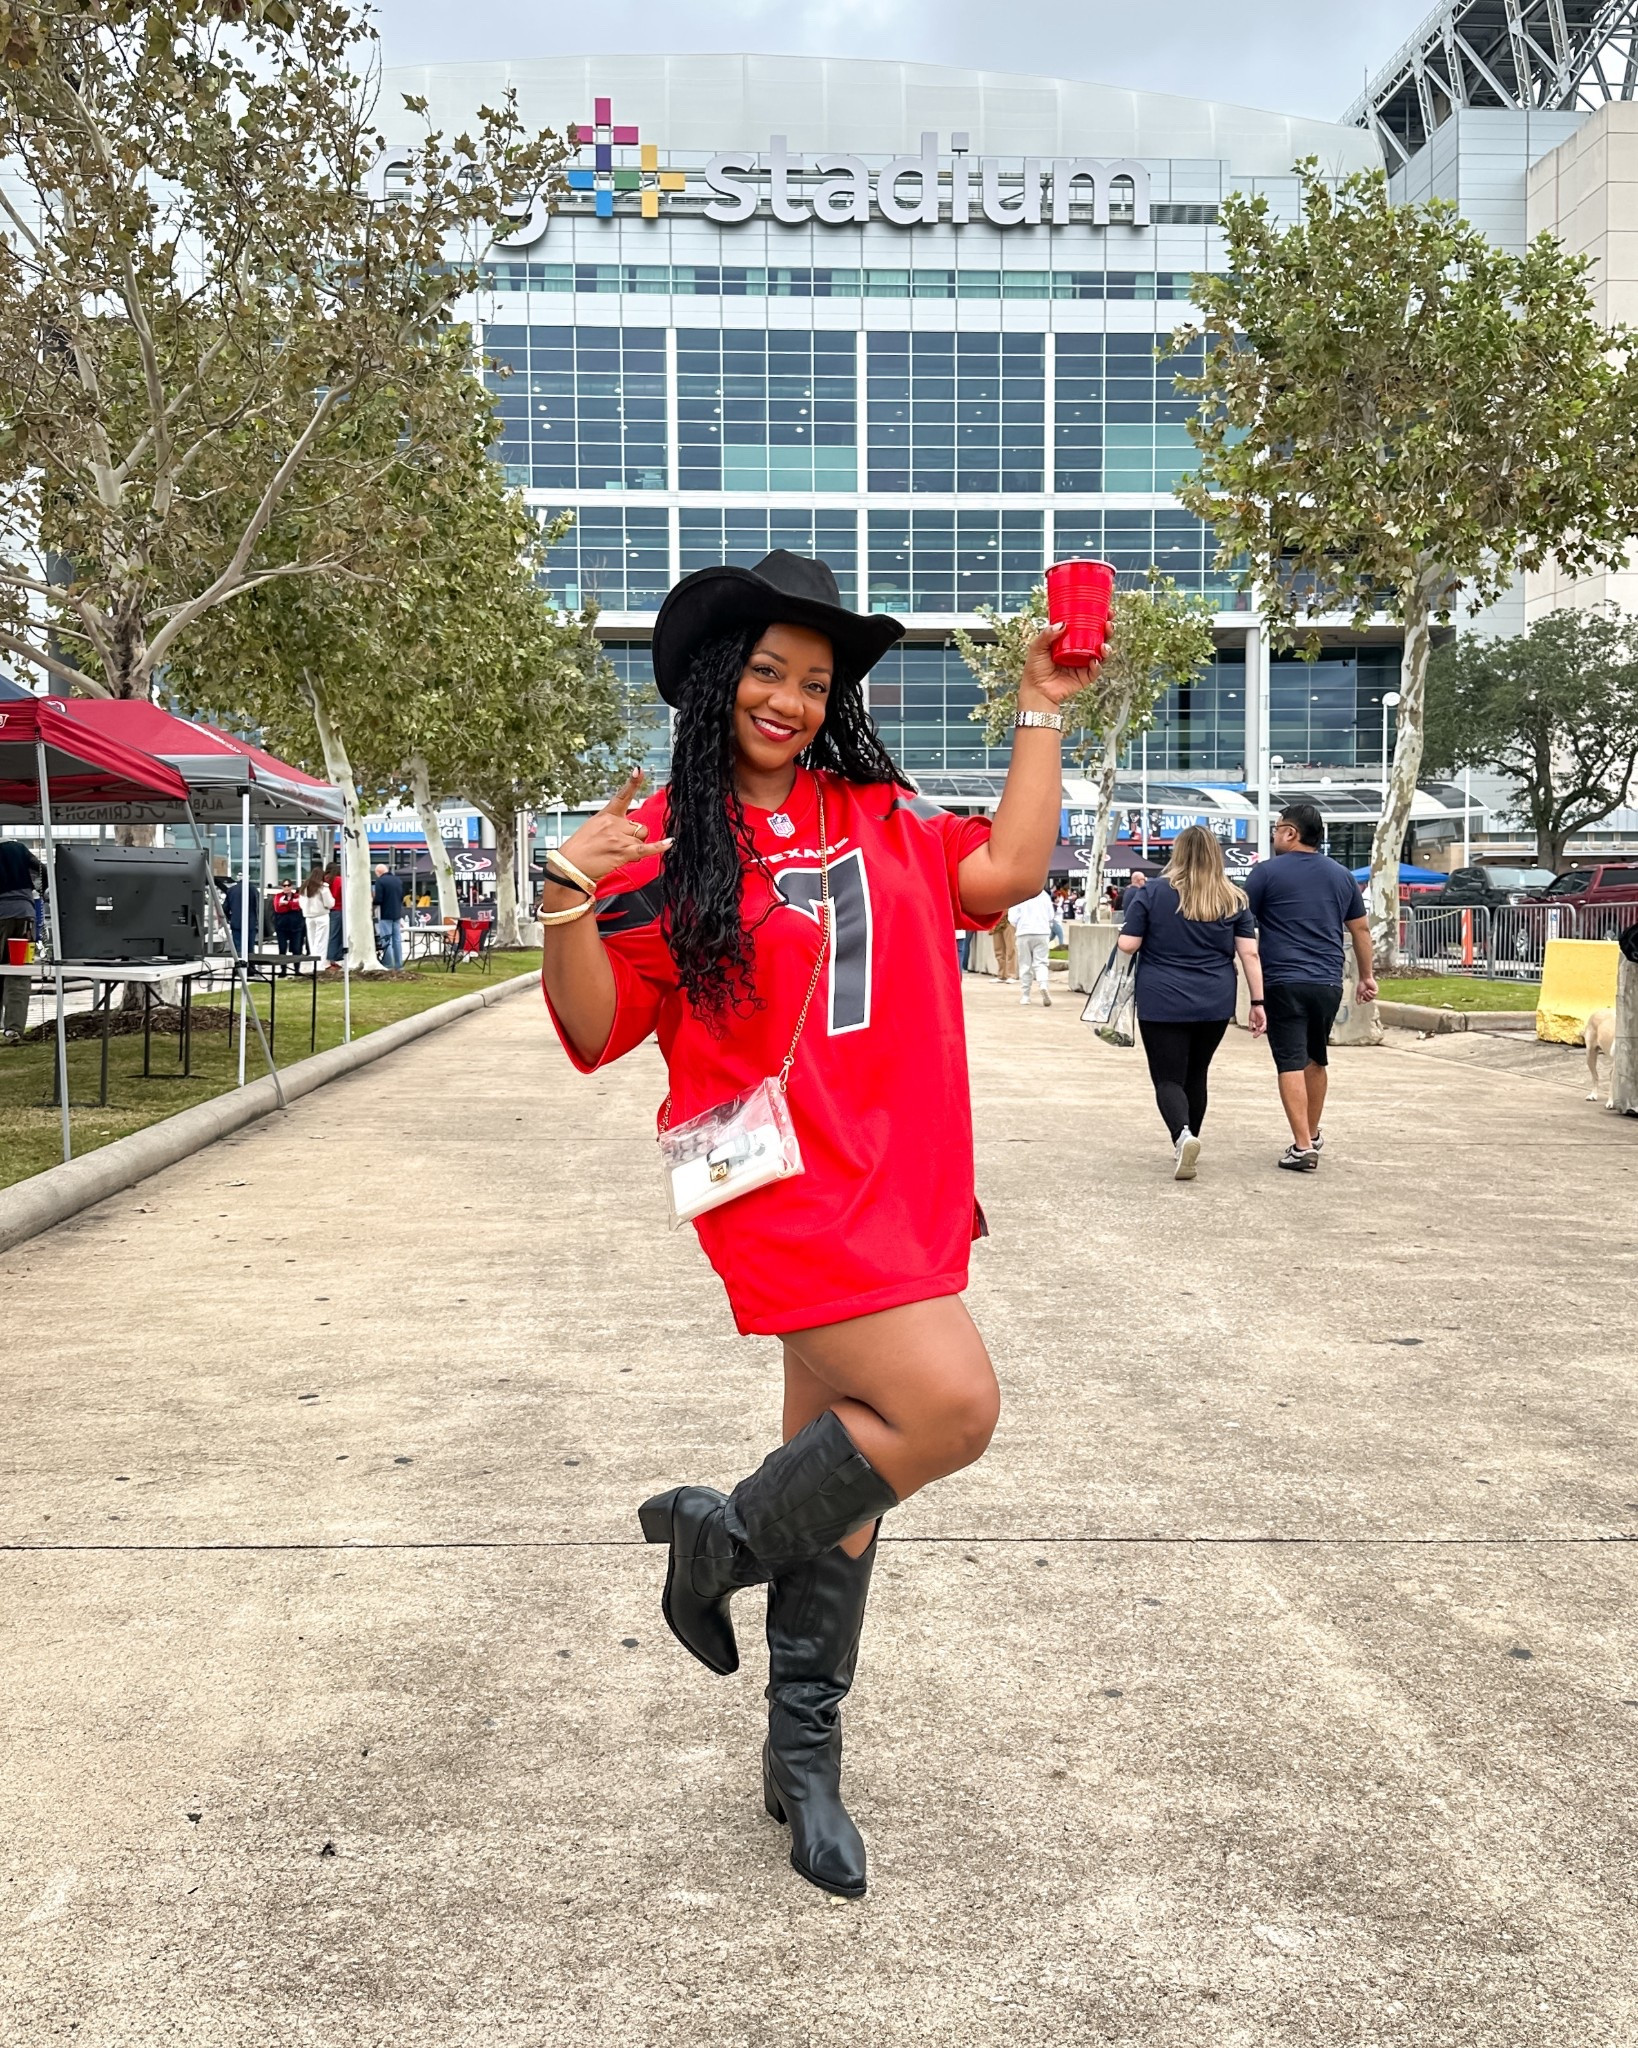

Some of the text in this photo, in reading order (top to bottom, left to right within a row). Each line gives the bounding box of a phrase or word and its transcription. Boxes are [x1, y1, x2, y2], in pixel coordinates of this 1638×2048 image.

[702, 131, 1151, 227] stadium
[1070, 814, 1097, 826] BUD
[1159, 815, 1198, 831] ENJOY
[1068, 825, 1096, 837] LIGH
[750, 836, 849, 866] TEXANS
[454, 871, 473, 880] STON
[1068, 868, 1131, 878] HOUS TEXANS
